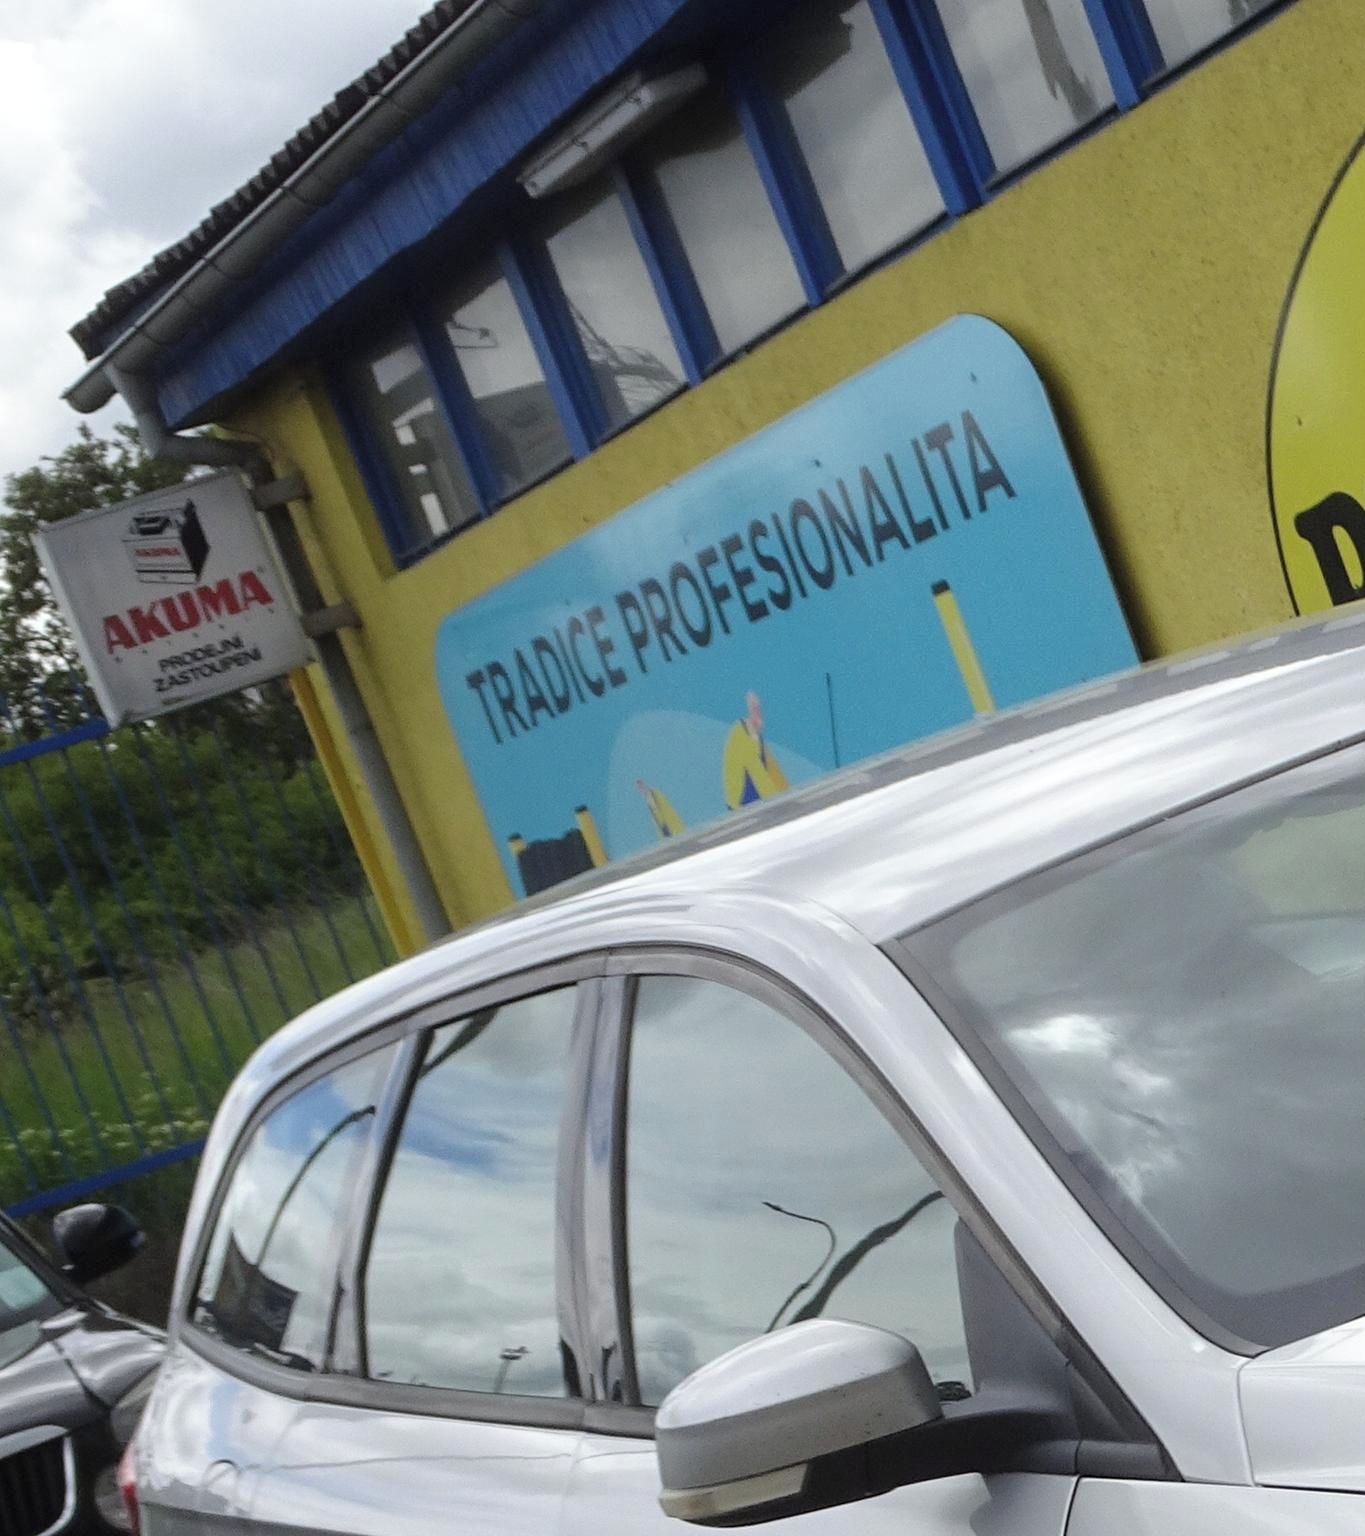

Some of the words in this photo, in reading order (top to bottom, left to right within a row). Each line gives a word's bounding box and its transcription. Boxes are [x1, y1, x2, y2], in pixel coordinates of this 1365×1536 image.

[103, 570, 274, 655] AKUMA
[466, 606, 628, 745] TRADICE
[615, 408, 1018, 674] PROFESIONALITA
